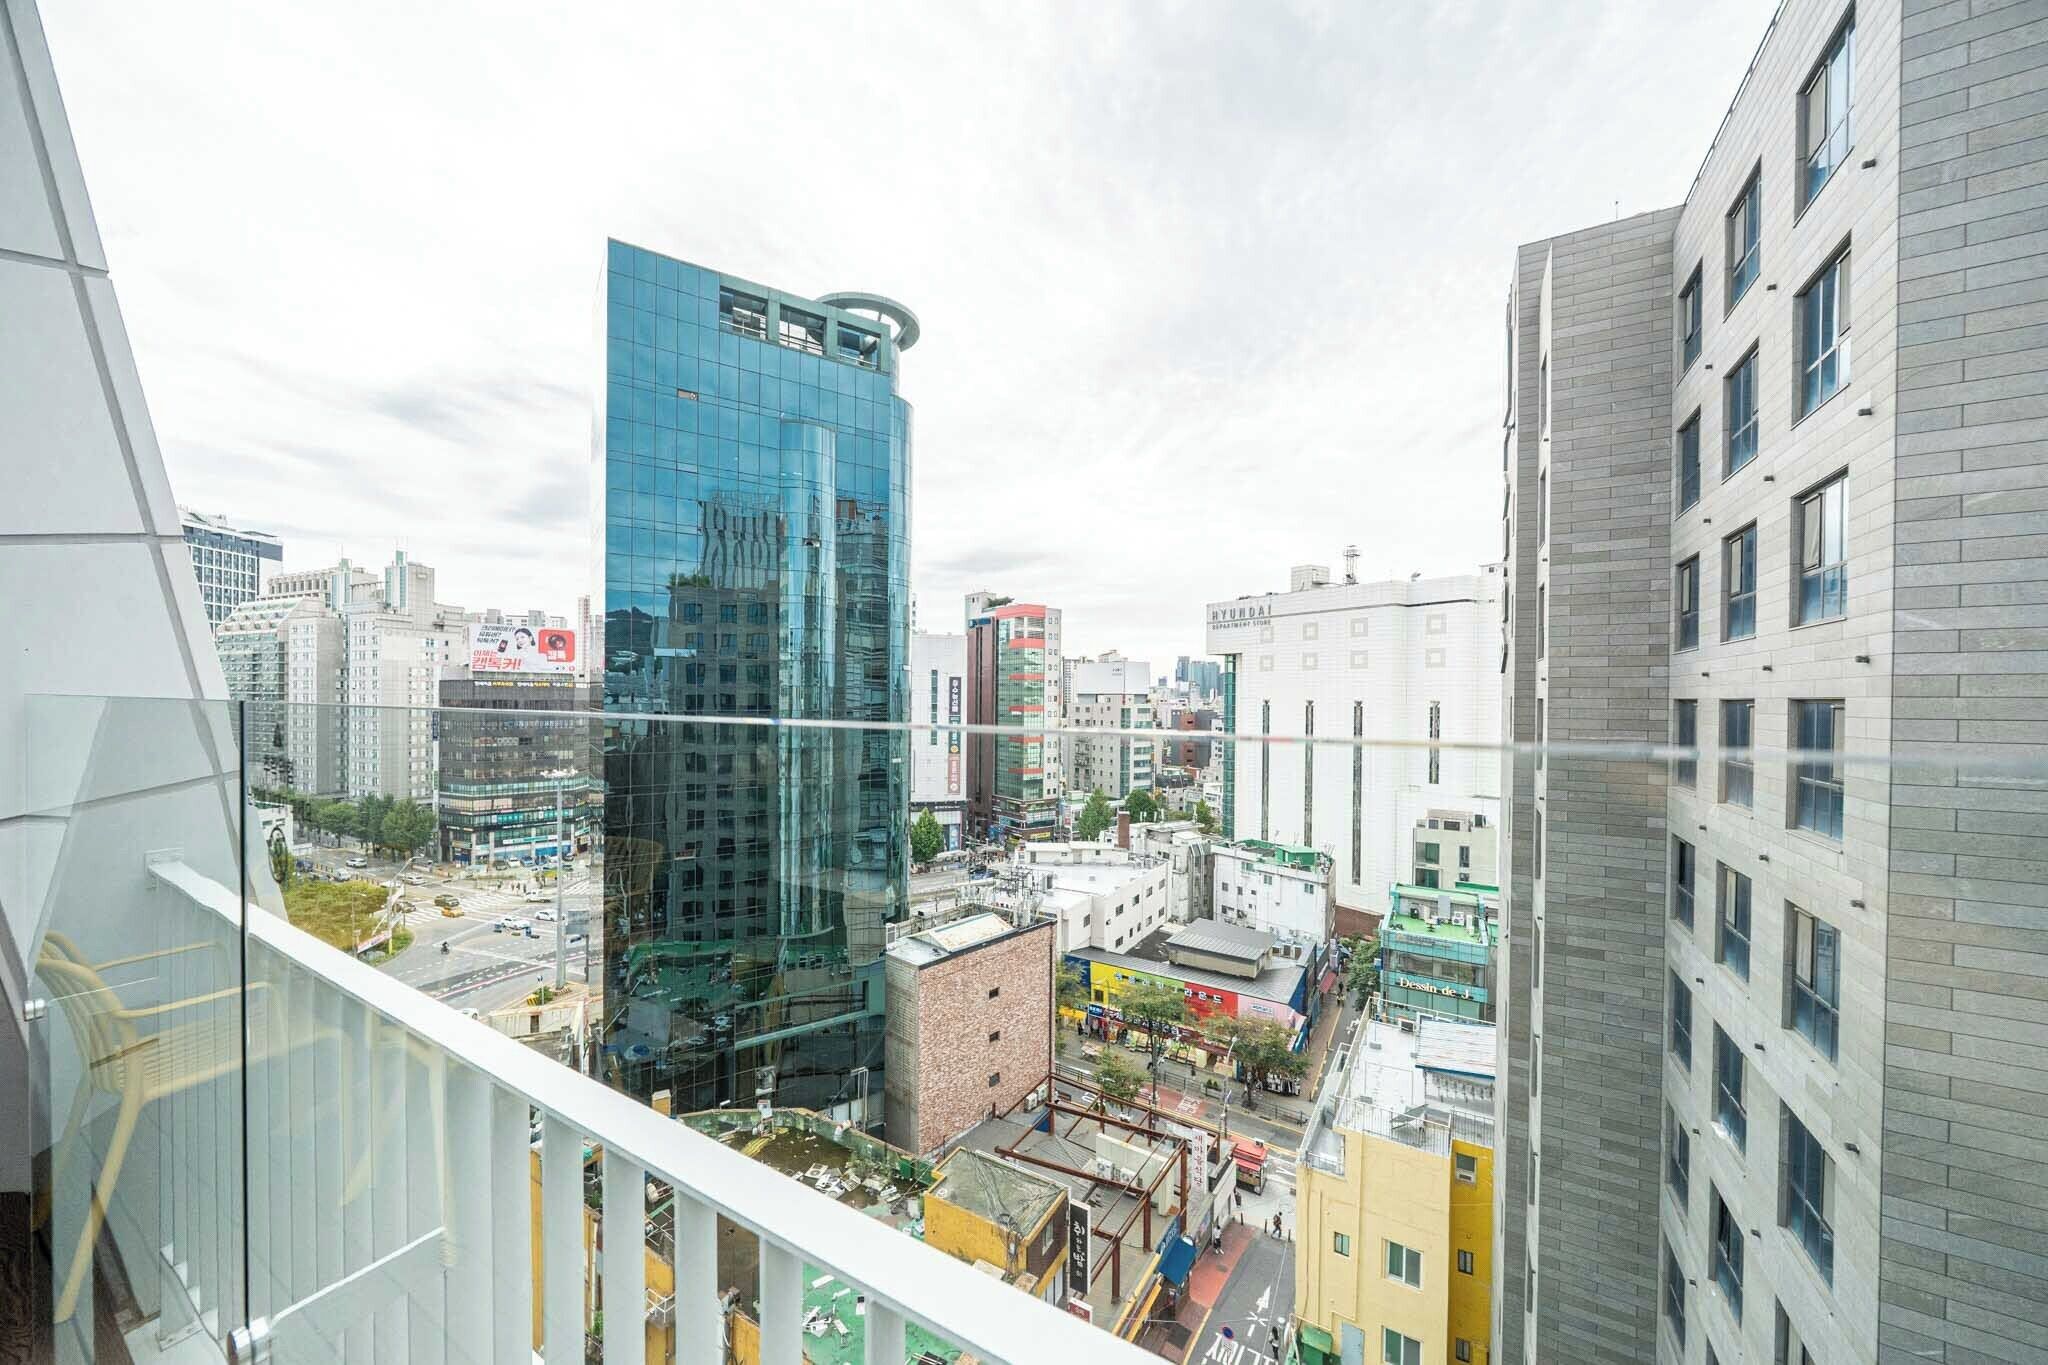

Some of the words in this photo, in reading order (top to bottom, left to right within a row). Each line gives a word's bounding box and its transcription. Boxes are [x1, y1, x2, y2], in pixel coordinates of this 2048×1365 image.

[1212, 604, 1271, 621] HYUNDAI
[1212, 621, 1252, 630] DEPARTMENT
[1253, 619, 1271, 627] STORE
[472, 657, 522, 670] 캠톡커!
[1399, 977, 1437, 993] Dessin
[1441, 986, 1457, 997] de
